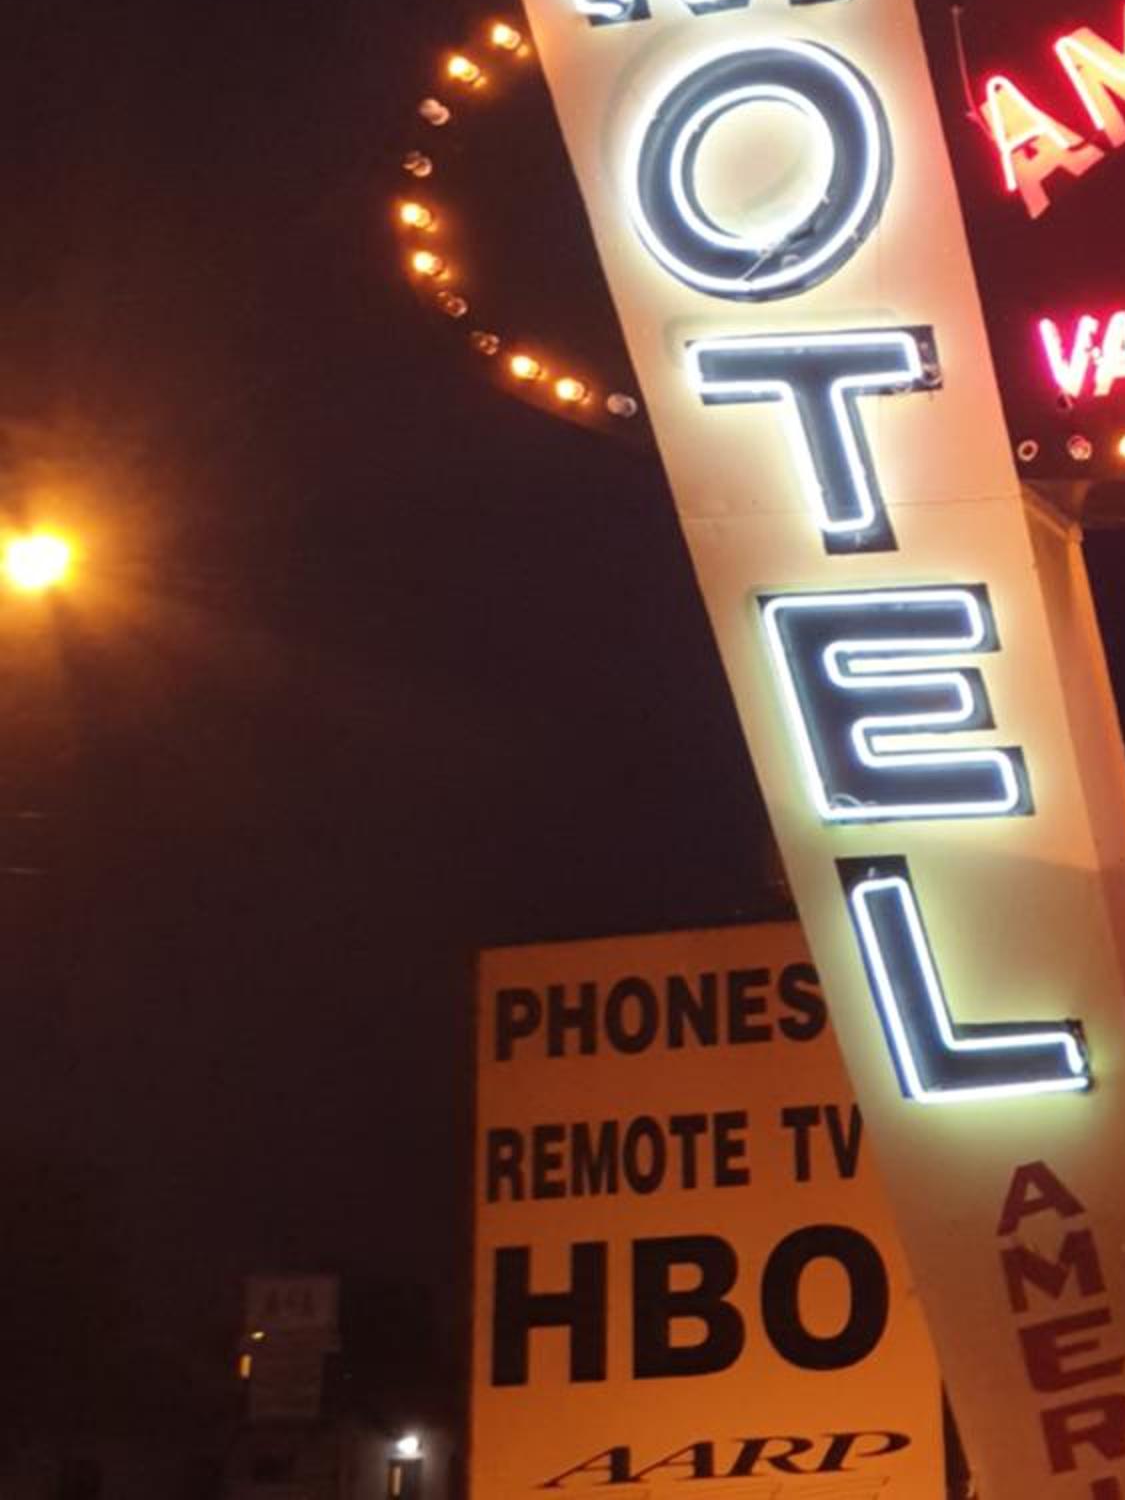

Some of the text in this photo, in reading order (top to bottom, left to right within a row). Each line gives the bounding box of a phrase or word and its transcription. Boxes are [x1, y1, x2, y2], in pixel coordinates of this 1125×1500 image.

[495, 962, 828, 1061] PHONES
[485, 1103, 864, 1202] REMOTE TV
[490, 1224, 889, 1387] HBO
[535, 1431, 911, 1488] AARP
